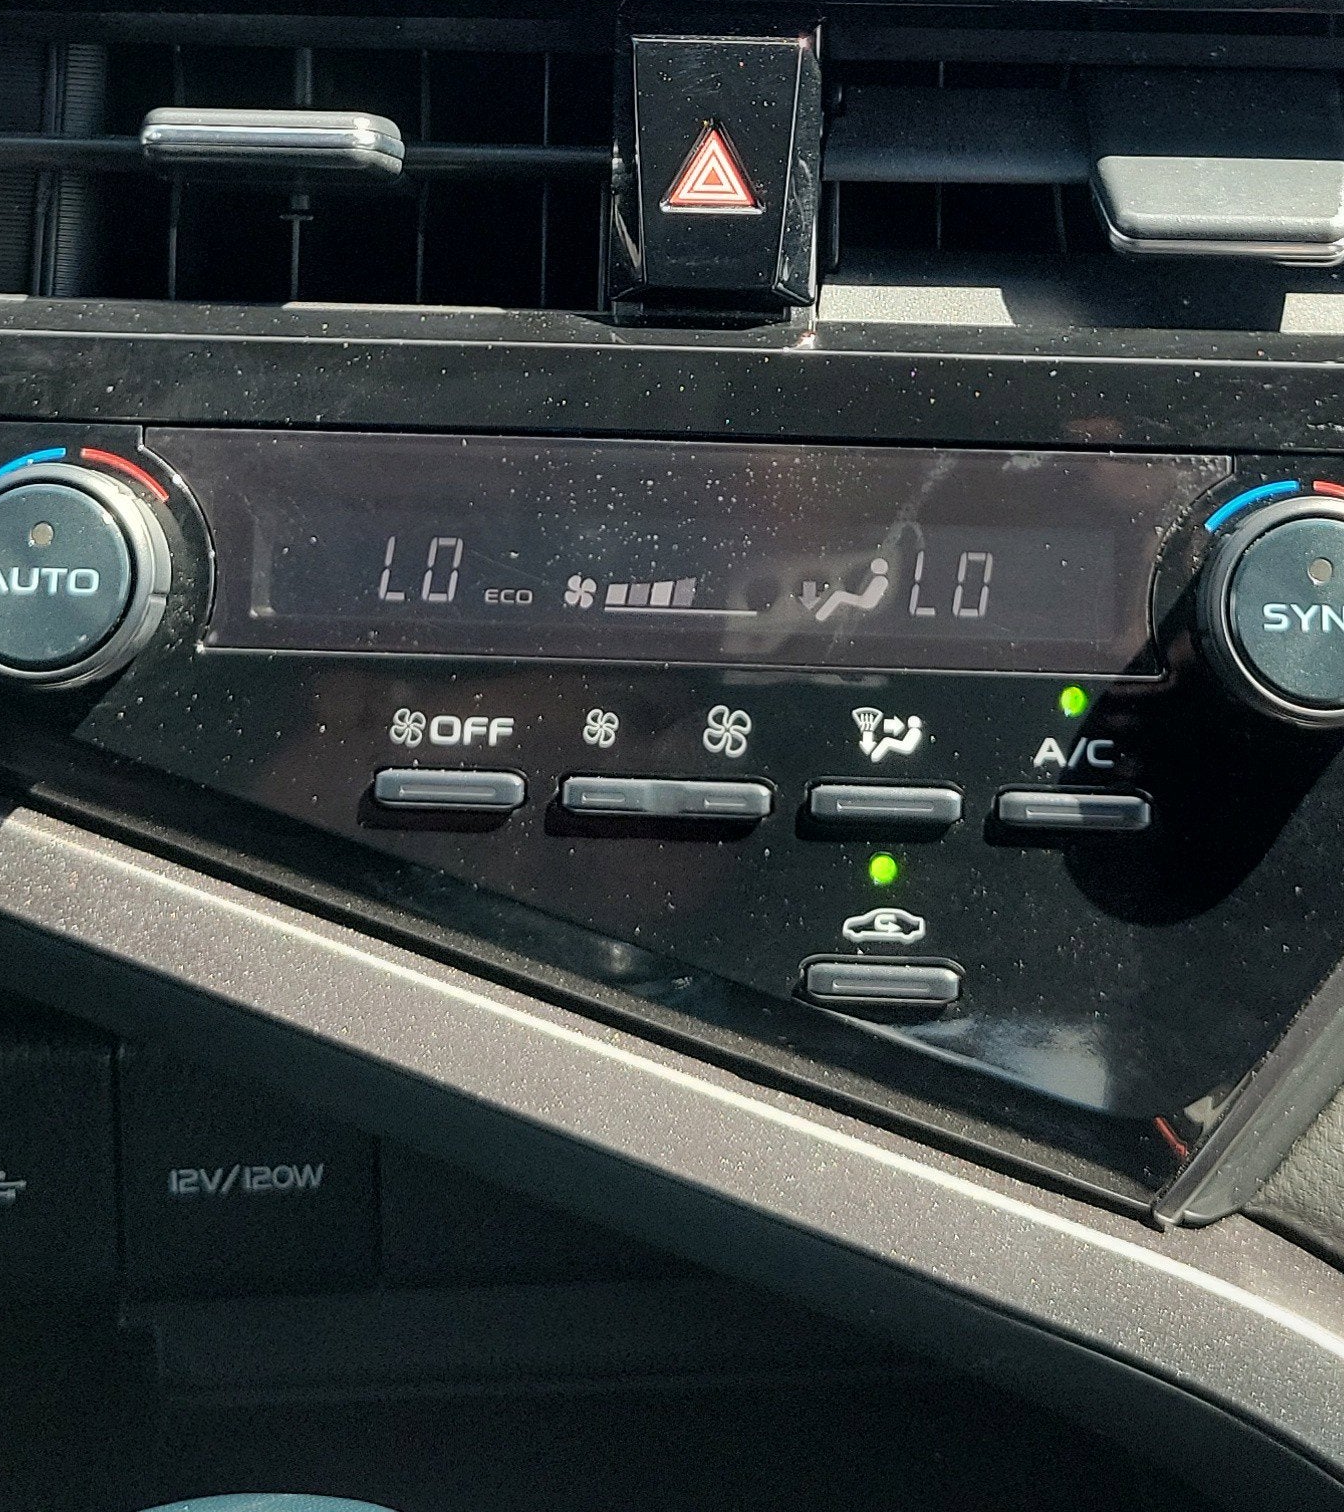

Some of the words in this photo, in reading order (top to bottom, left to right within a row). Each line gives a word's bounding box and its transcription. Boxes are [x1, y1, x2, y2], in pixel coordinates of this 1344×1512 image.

[379, 537, 463, 602] LO
[484, 589, 533, 605] ECO
[910, 552, 993, 618] LO
[430, 716, 514, 746] OFF
[1033, 738, 1112, 767] A/C
[169, 1164, 323, 1193] 12V/120W
